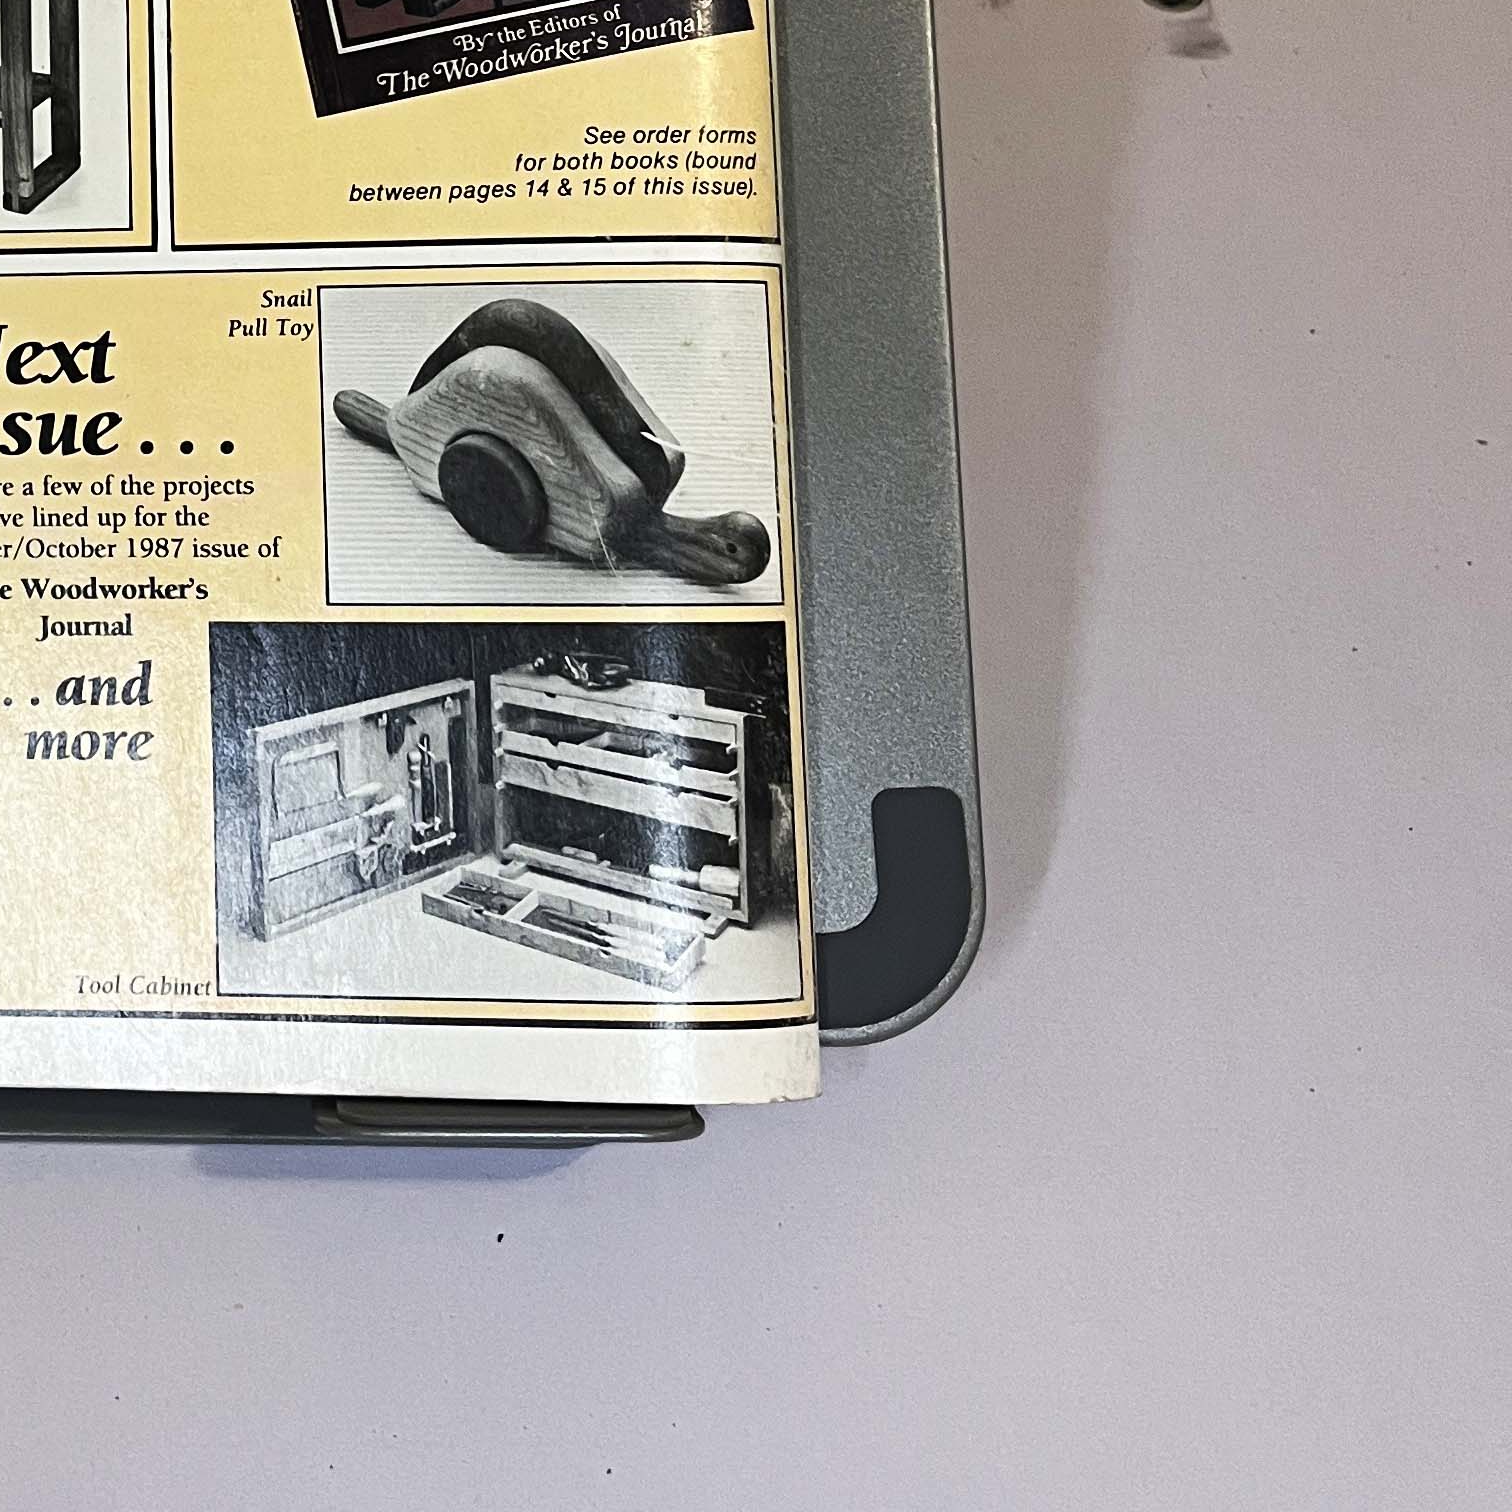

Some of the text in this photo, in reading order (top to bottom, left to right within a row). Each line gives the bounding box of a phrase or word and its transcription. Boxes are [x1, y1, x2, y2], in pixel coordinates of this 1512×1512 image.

[453, 4, 622, 52] By the Editors of
[377, 10, 704, 96] The Woodworker's Journal
[584, 125, 757, 145] See order forms
[515, 151, 757, 172] for both books (bound
[349, 177, 757, 203] between pages 14 & 15 of this issue).
[261, 290, 313, 308] Snail
[228, 318, 314, 341] Pull Toy
[22, 482, 34, 496] a
[43, 475, 83, 496] few
[91, 474, 115, 495] of
[121, 474, 155, 495] the
[163, 475, 254, 502] projects
[32, 505, 88, 527] lined
[98, 512, 126, 533] up
[135, 505, 167, 526] for
[175, 505, 209, 526] the
[128, 537, 184, 558] 1987
[193, 538, 249, 558] issue
[258, 536, 282, 558] of
[20, 576, 208, 600] Woodworker's
[36, 614, 133, 642] Journal
[25, 729, 154, 761] more
[76, 975, 212, 997] Tool Cabinet
